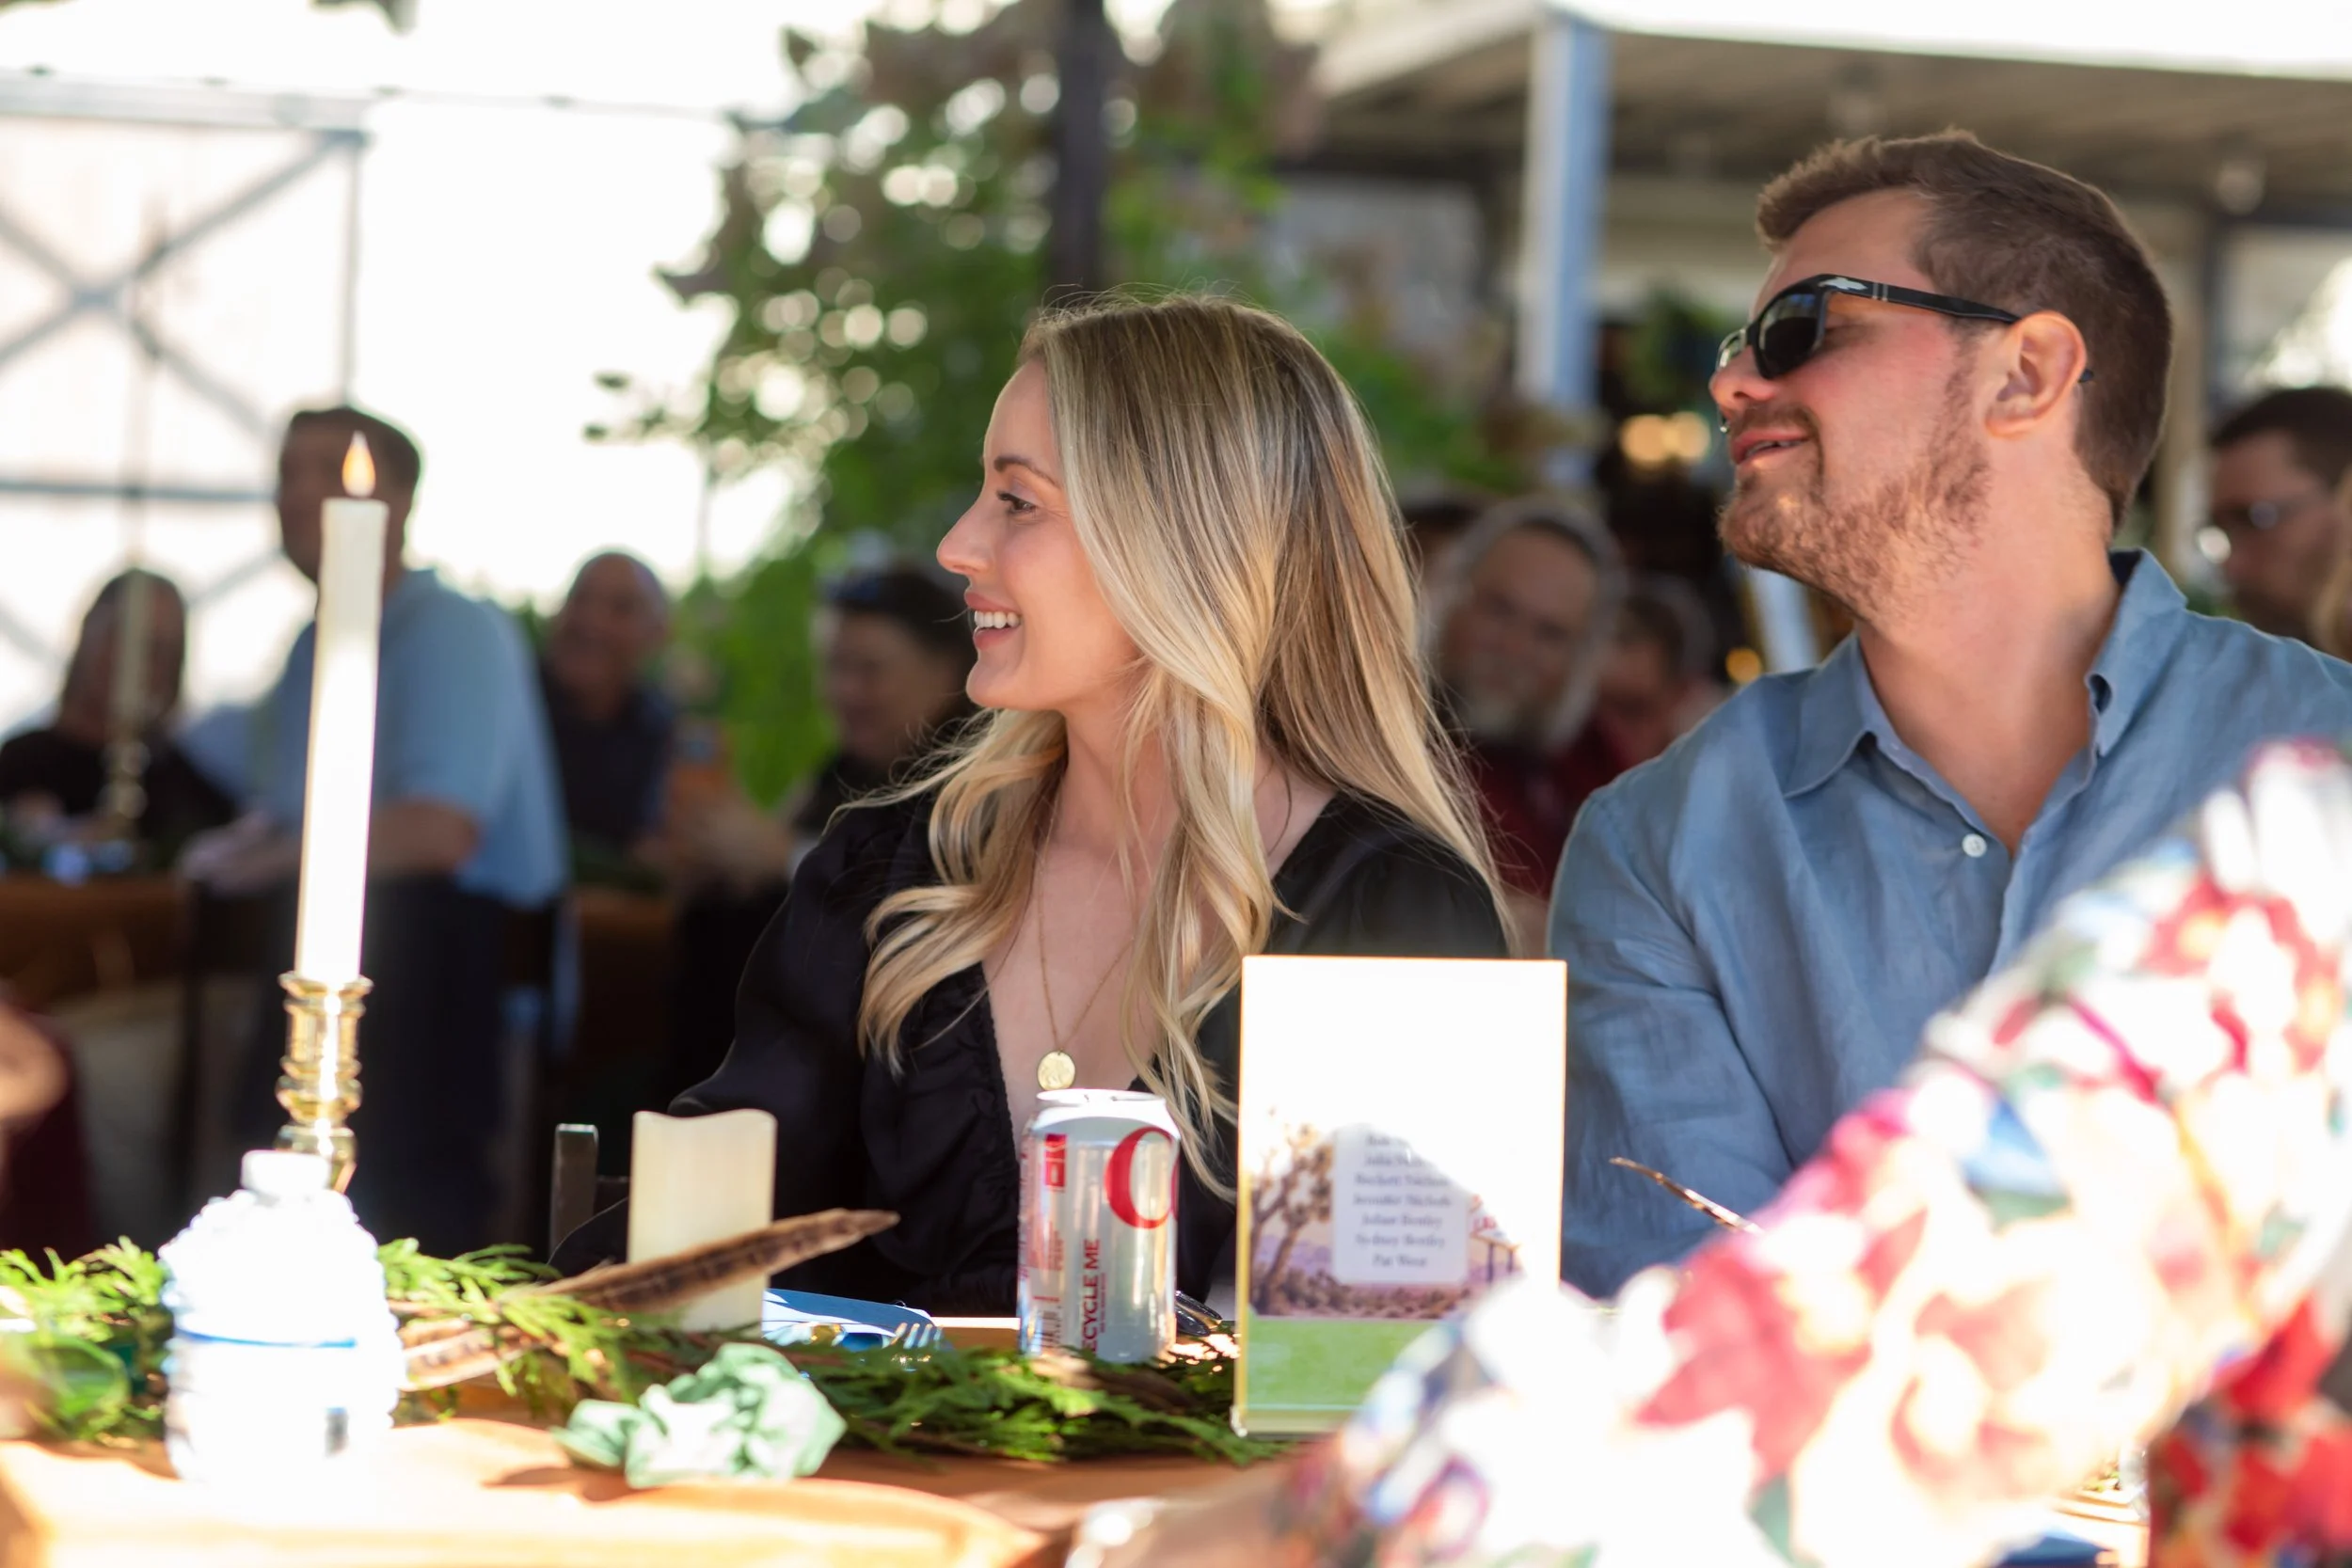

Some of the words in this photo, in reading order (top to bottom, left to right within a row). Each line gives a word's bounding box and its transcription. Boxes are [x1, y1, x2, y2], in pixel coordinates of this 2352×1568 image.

[1104, 1126, 1180, 1229] C
[1083, 1238, 1100, 1270] ME
[1082, 1274, 1099, 1354] ECYCLE
